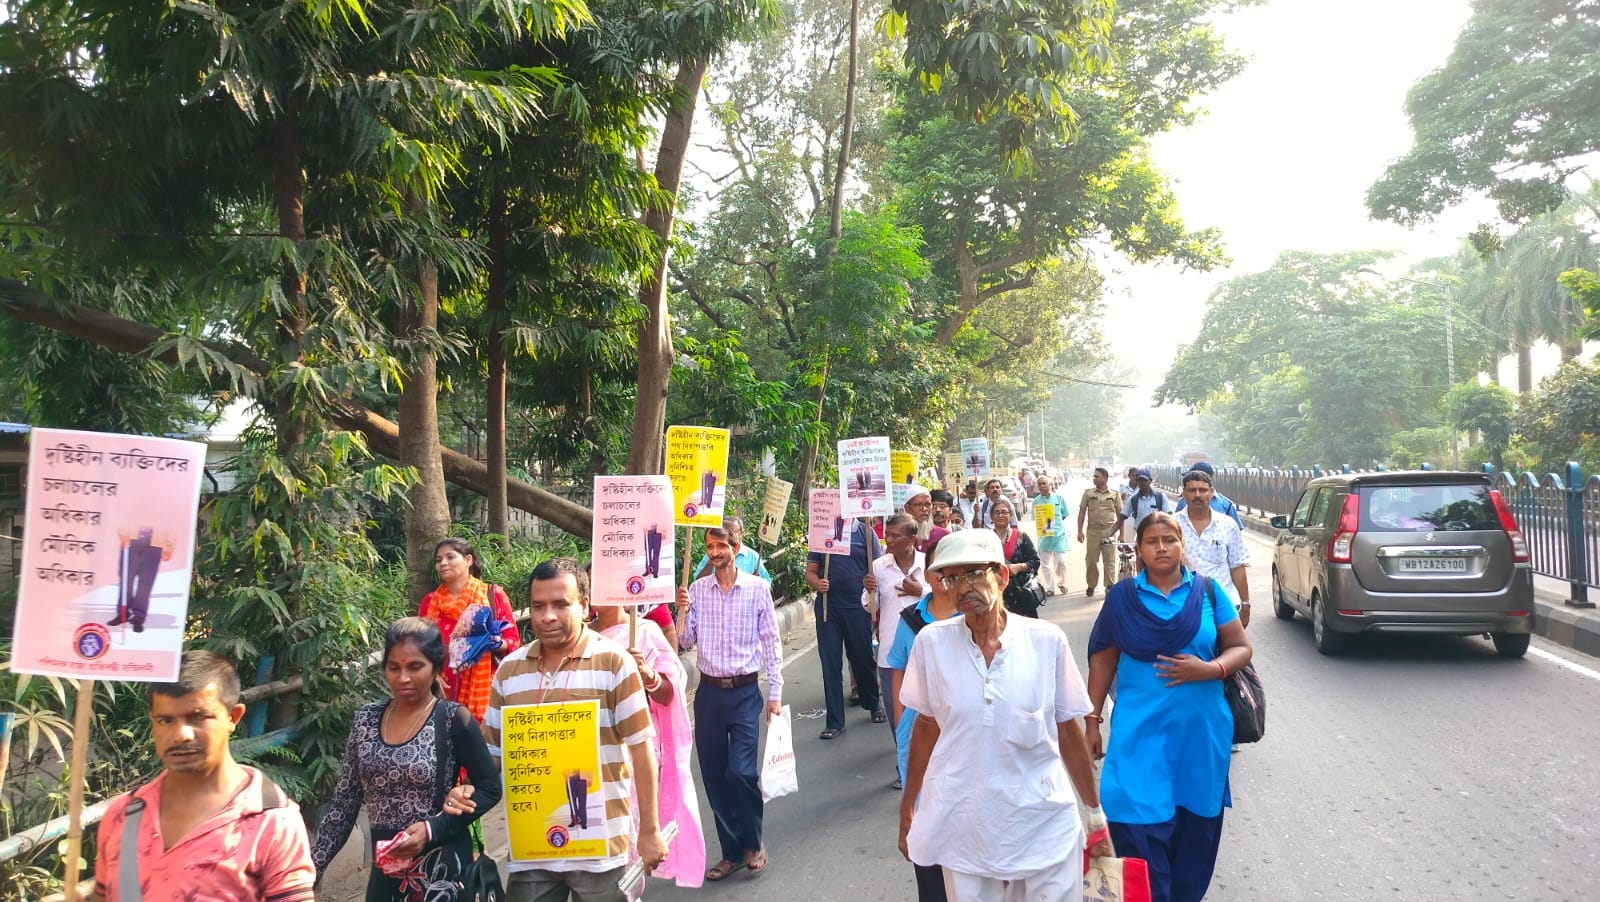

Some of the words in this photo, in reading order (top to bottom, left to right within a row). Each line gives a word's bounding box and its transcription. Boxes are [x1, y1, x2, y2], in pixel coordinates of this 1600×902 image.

[44, 442, 103, 468] দৃষ্টিহীন
[109, 448, 190, 473] ব্যক্তিদের
[42, 477, 118, 497] চলাচলের
[602, 482, 633, 498] দৃষ্টিহীন
[41, 503, 103, 525] অধিকার
[602, 501, 641, 511] চলাচলের
[601, 515, 635, 528] অধিকার
[40, 533, 97, 555] মৌলিক
[602, 531, 635, 543] মৌলিক
[600, 547, 635, 559] অধিকার
[36, 562, 95, 586] অধিকার
[508, 711, 544, 729] দৃষ্টিহীন
[547, 708, 593, 725] ব্যক্তিদের
[508, 733, 525, 744] পথ
[528, 728, 576, 742] নিরাপত্তার
[508, 746, 547, 761] অধিকার
[509, 763, 552, 781] সুনিশ্চিত
[510, 783, 541, 795] করতে
[511, 801, 539, 813] হবে।
